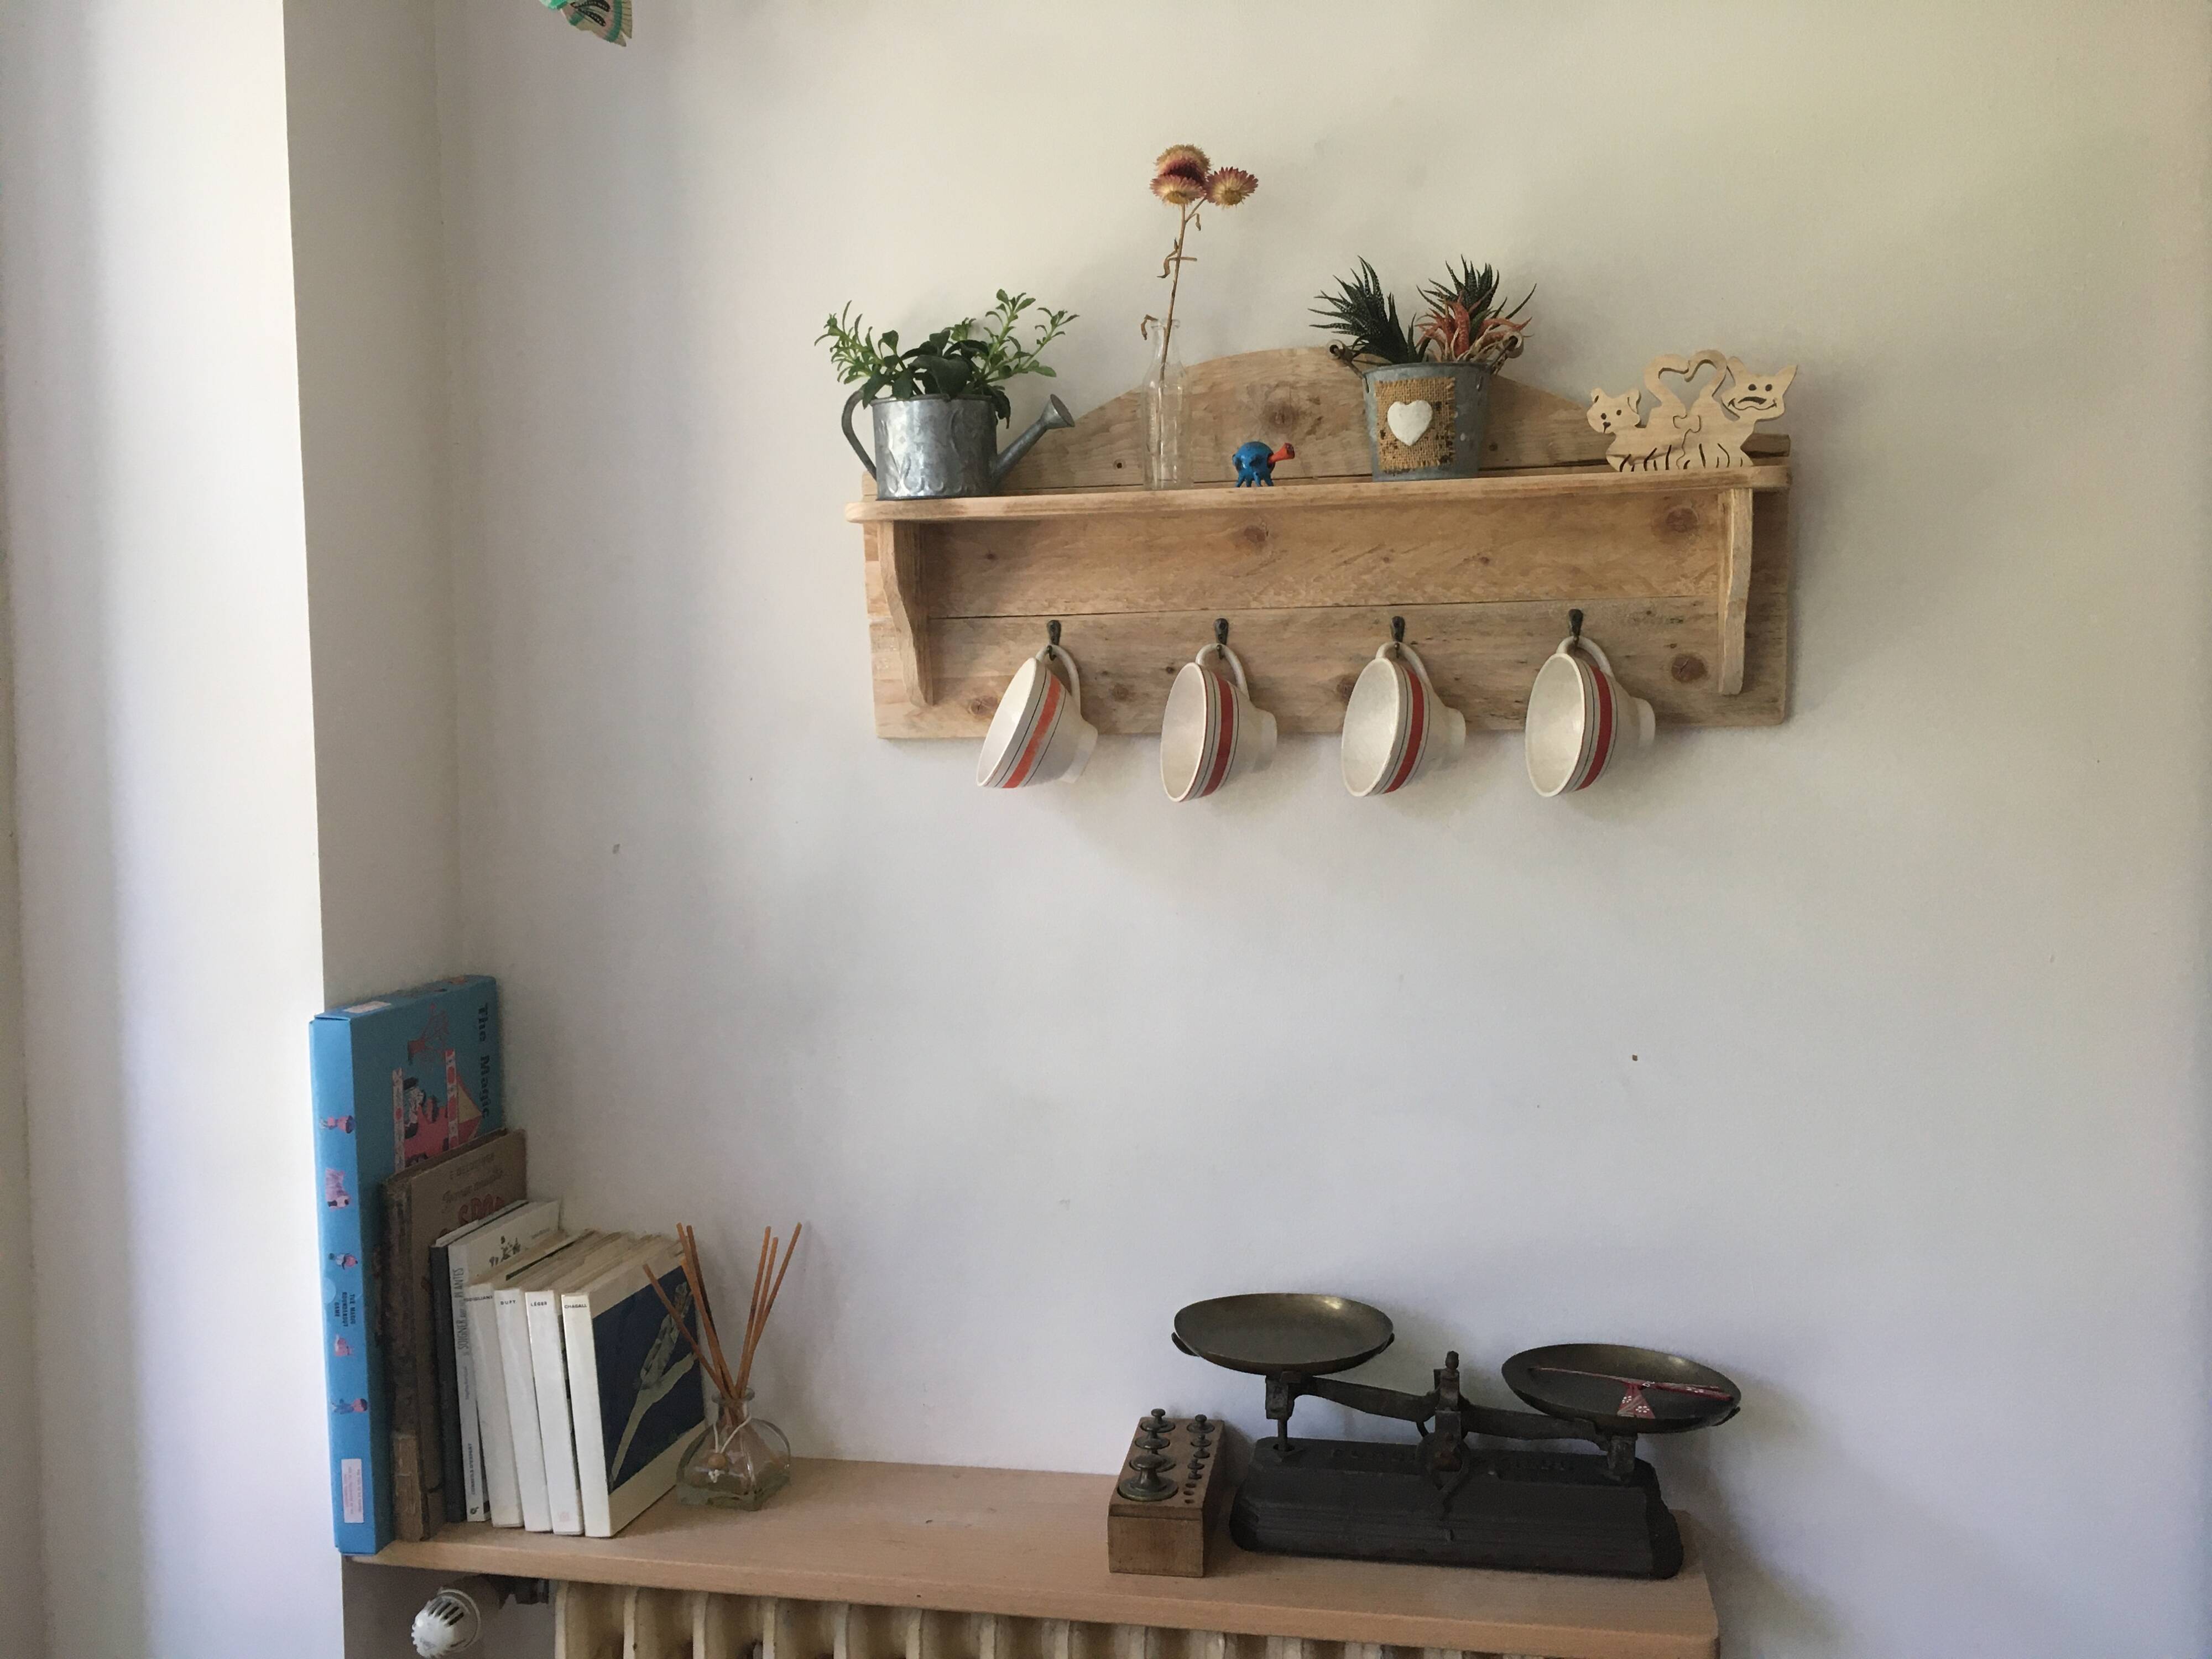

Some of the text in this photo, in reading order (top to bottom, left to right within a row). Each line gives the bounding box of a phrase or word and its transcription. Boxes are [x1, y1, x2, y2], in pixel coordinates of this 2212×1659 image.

[478, 1003, 491, 1119] The Magic
[453, 1267, 464, 1298] PLANTES
[457, 1319, 469, 1350] SOIGNER
